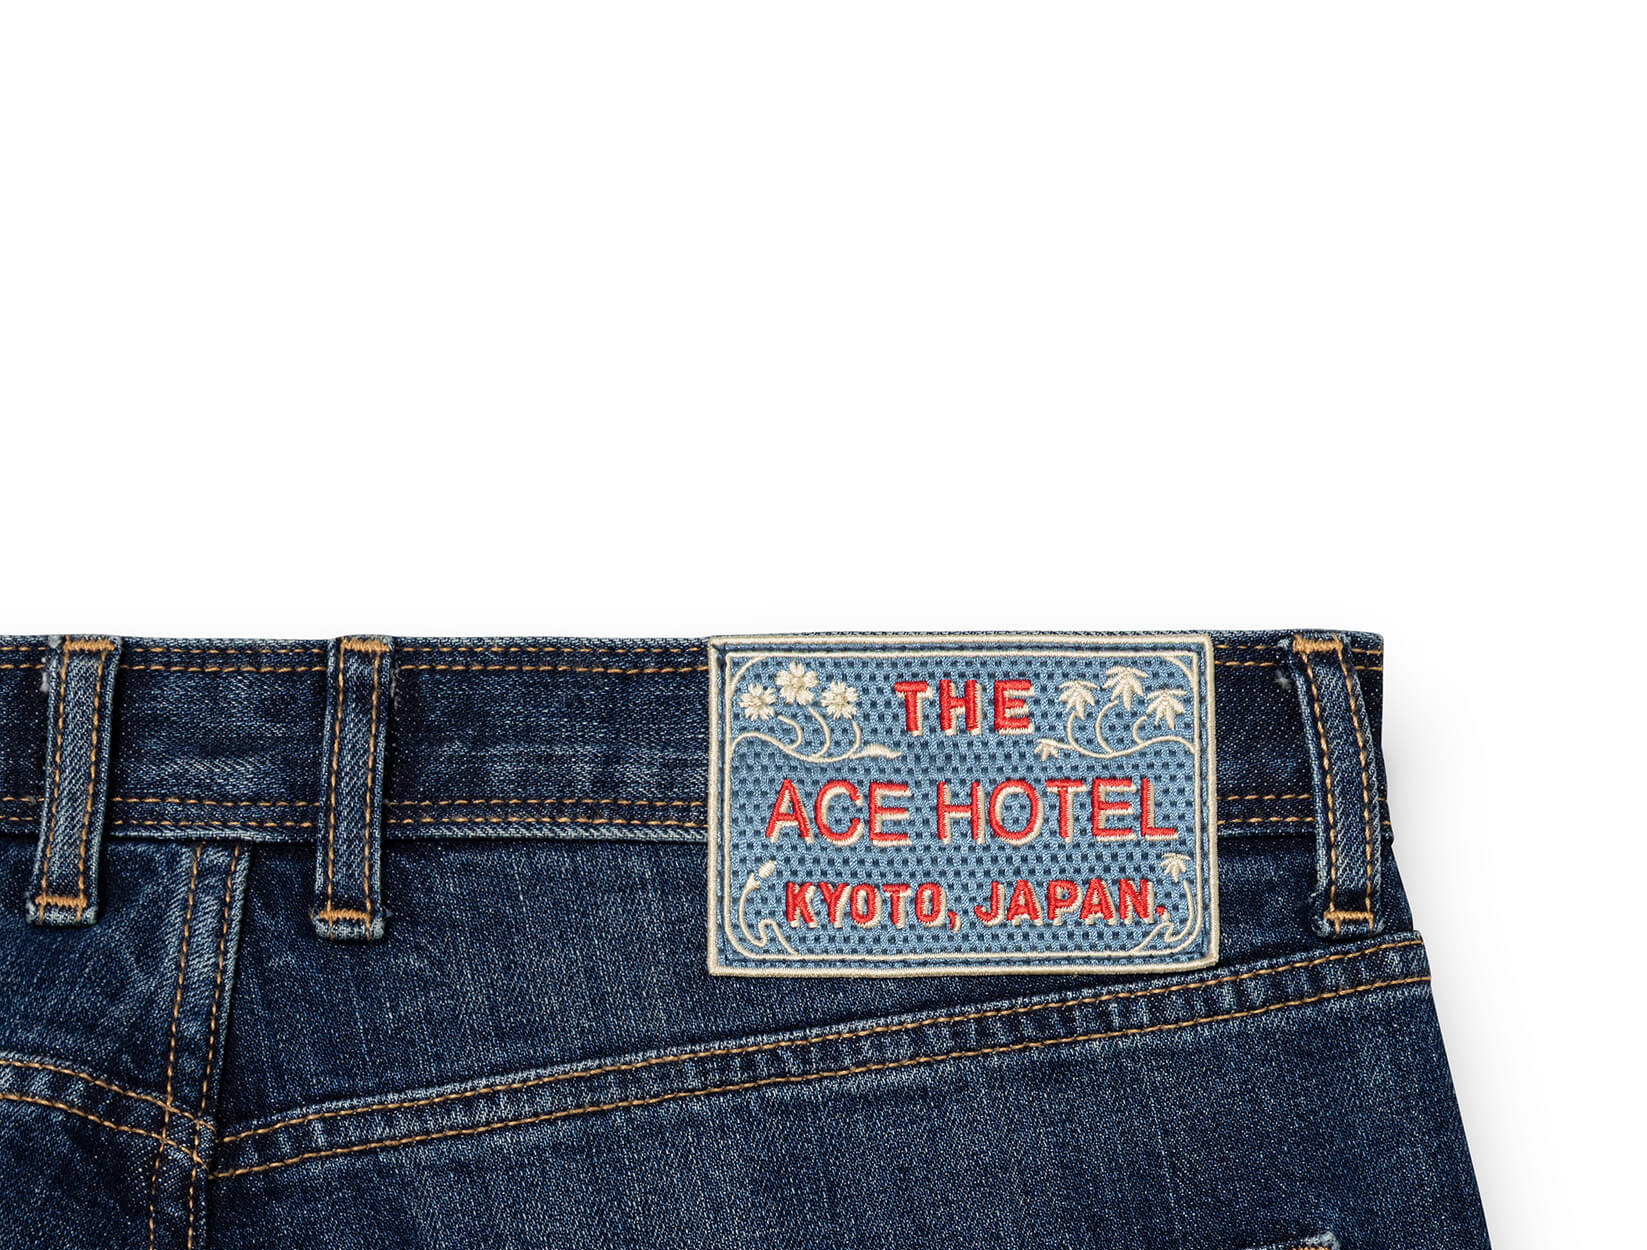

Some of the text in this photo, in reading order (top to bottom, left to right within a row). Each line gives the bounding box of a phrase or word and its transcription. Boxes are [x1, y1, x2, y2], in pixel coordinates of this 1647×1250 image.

[893, 678, 1035, 737] THE
[764, 777, 1179, 847] ACE HOTEL
[785, 881, 961, 932] KYOTO,
